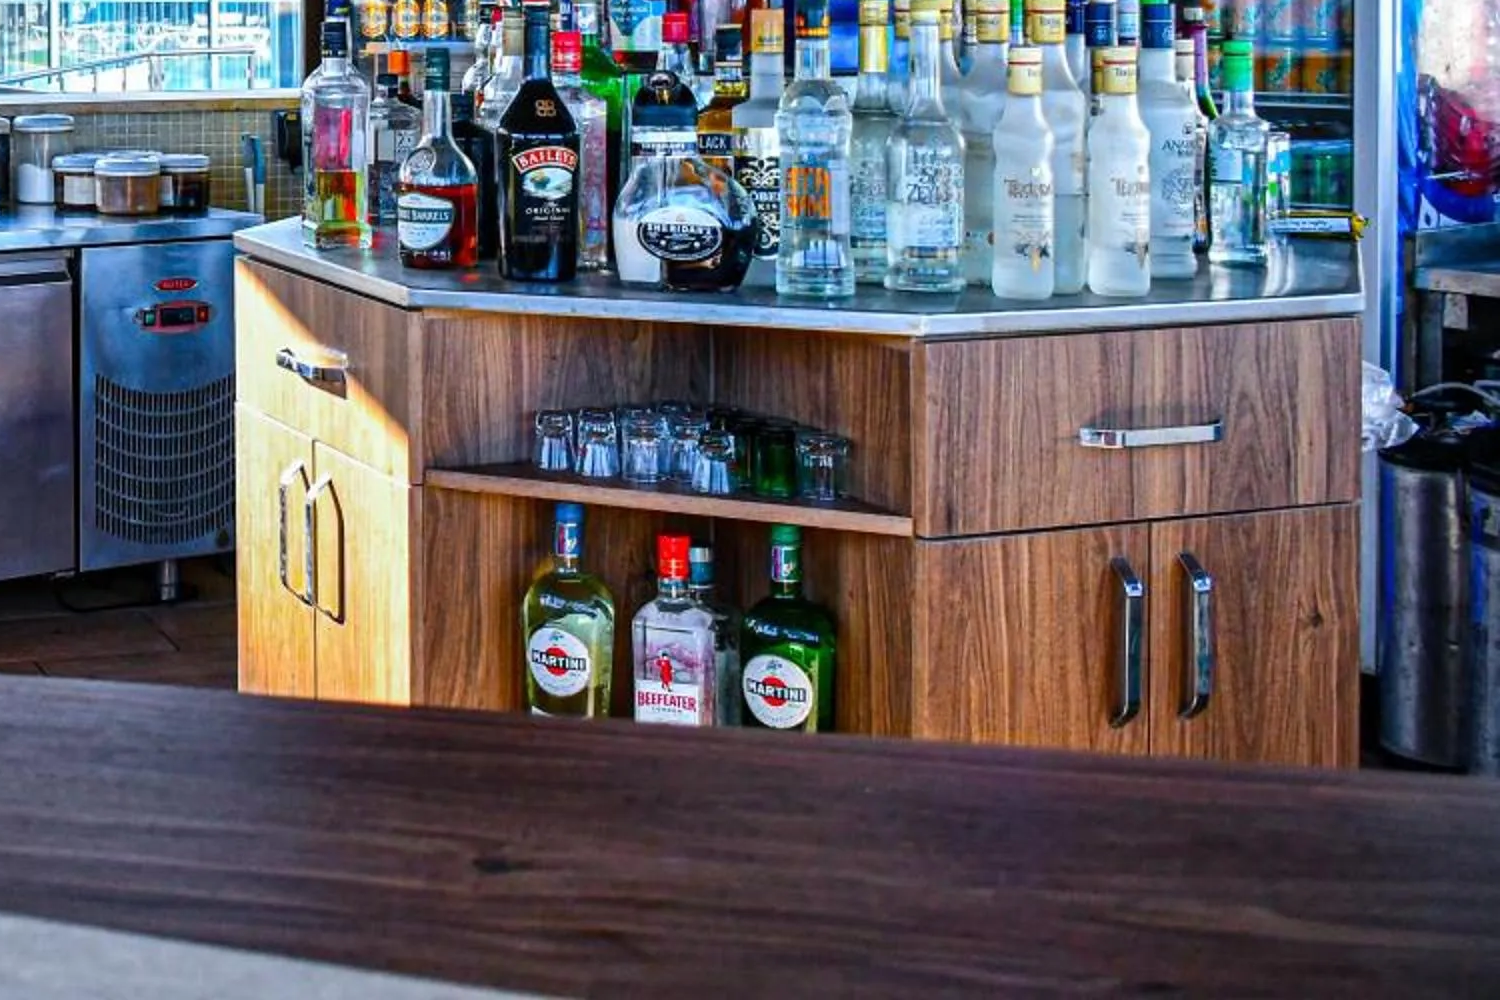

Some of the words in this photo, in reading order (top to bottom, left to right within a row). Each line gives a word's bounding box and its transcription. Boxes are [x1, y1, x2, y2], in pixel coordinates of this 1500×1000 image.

[699, 135, 727, 149] LACK
[518, 150, 577, 168] BAILEYS
[532, 649, 586, 671] MARTINI
[746, 678, 806, 703] MARTINI
[637, 691, 697, 712] BEEFEATER
